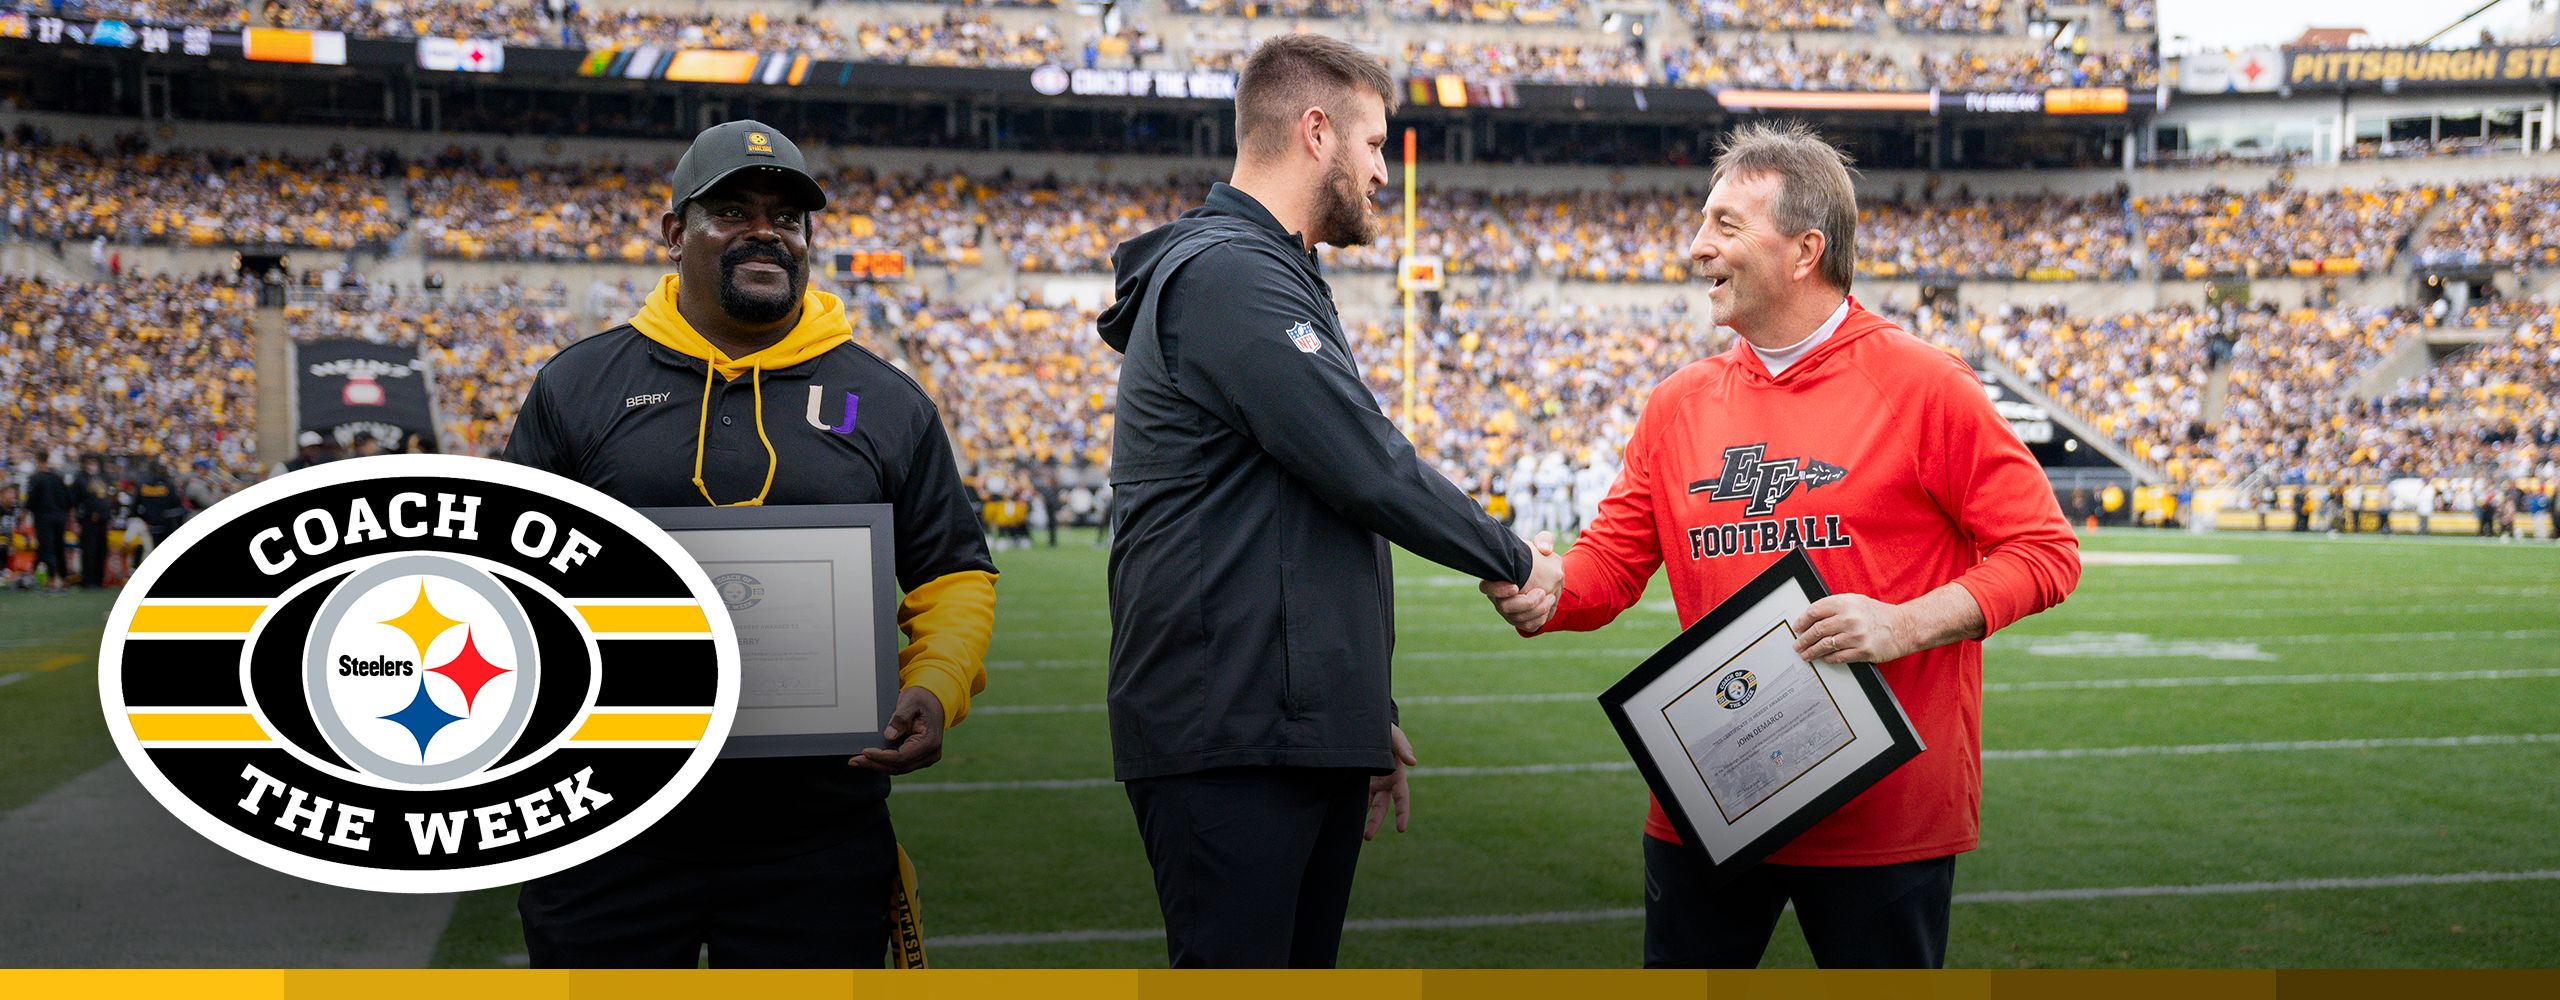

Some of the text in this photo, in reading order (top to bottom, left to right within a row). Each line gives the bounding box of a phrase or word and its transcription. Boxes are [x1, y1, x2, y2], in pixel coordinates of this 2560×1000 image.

[1071, 68, 1128, 95] COACH
[1129, 70, 1152, 96] OF
[2291, 48, 2497, 83] PITTSBURGH
[1297, 334, 1318, 350] NFL
[626, 392, 671, 408] BERRY
[806, 384, 859, 434] U
[1709, 443, 1800, 518] EF
[1688, 515, 1851, 560] FOOTBALL
[1736, 710, 1784, 747] JOHN DEMARCO
